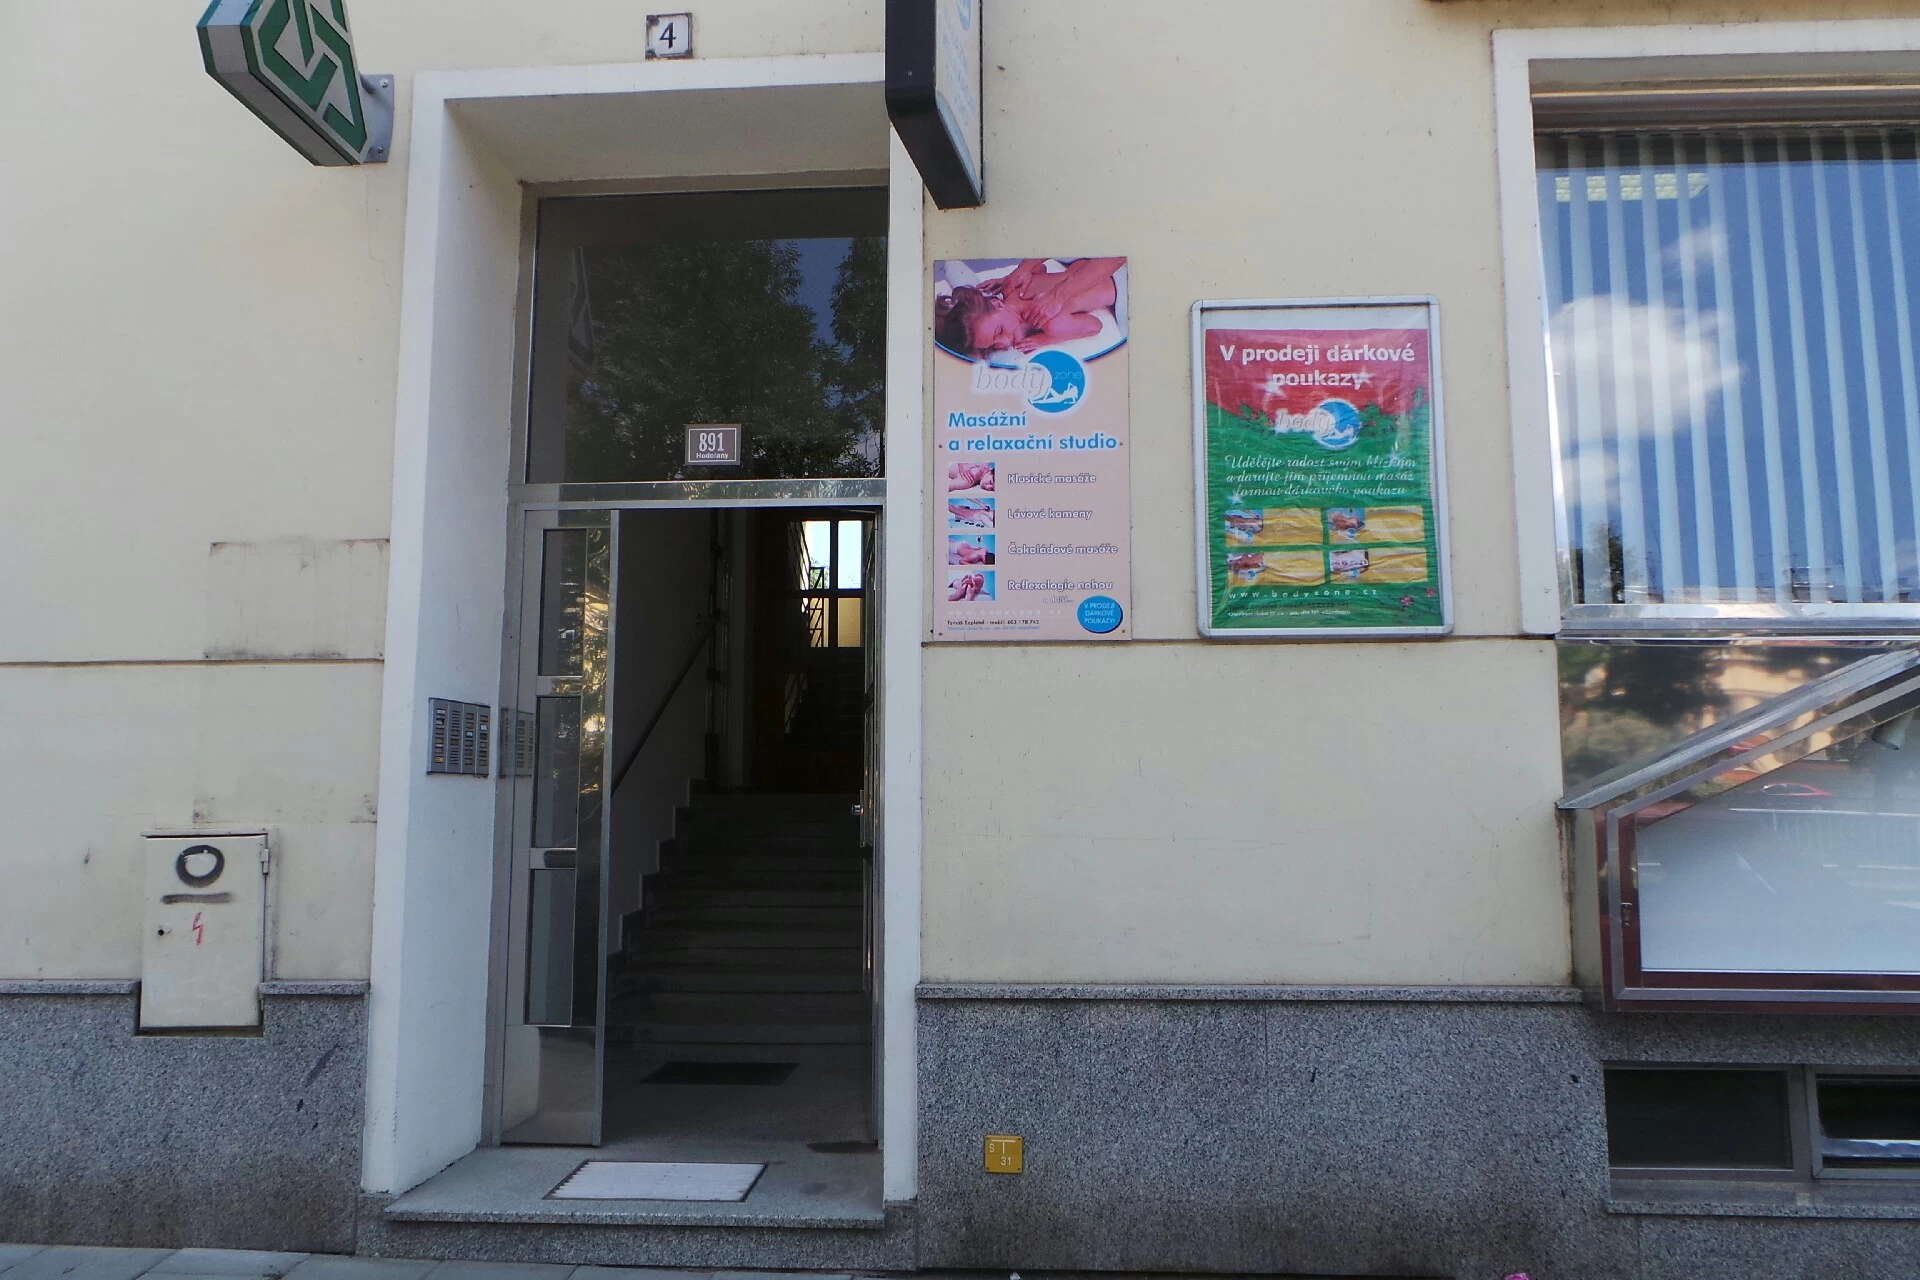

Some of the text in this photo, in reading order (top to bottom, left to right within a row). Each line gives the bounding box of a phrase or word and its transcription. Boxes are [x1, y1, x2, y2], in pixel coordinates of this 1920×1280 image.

[660, 22, 676, 49] 4
[1220, 343, 1415, 366] V prodeji dárkové
[976, 364, 1082, 397] body zone
[1272, 370, 1364, 390] poukazy
[948, 410, 1026, 428] Masážní
[698, 432, 724, 452] 891
[948, 433, 1117, 450] a relaxační studio
[1287, 454, 1325, 467] radost
[1008, 472, 1096, 484] Klasické masáže
[1238, 470, 1282, 486] darujte
[1008, 508, 1092, 520] Lávové kameny
[1008, 542, 1118, 554] Čokoládové masáže
[1008, 578, 1113, 592] Reflexologie nohou
[1001, 1156, 1011, 1166] 31
